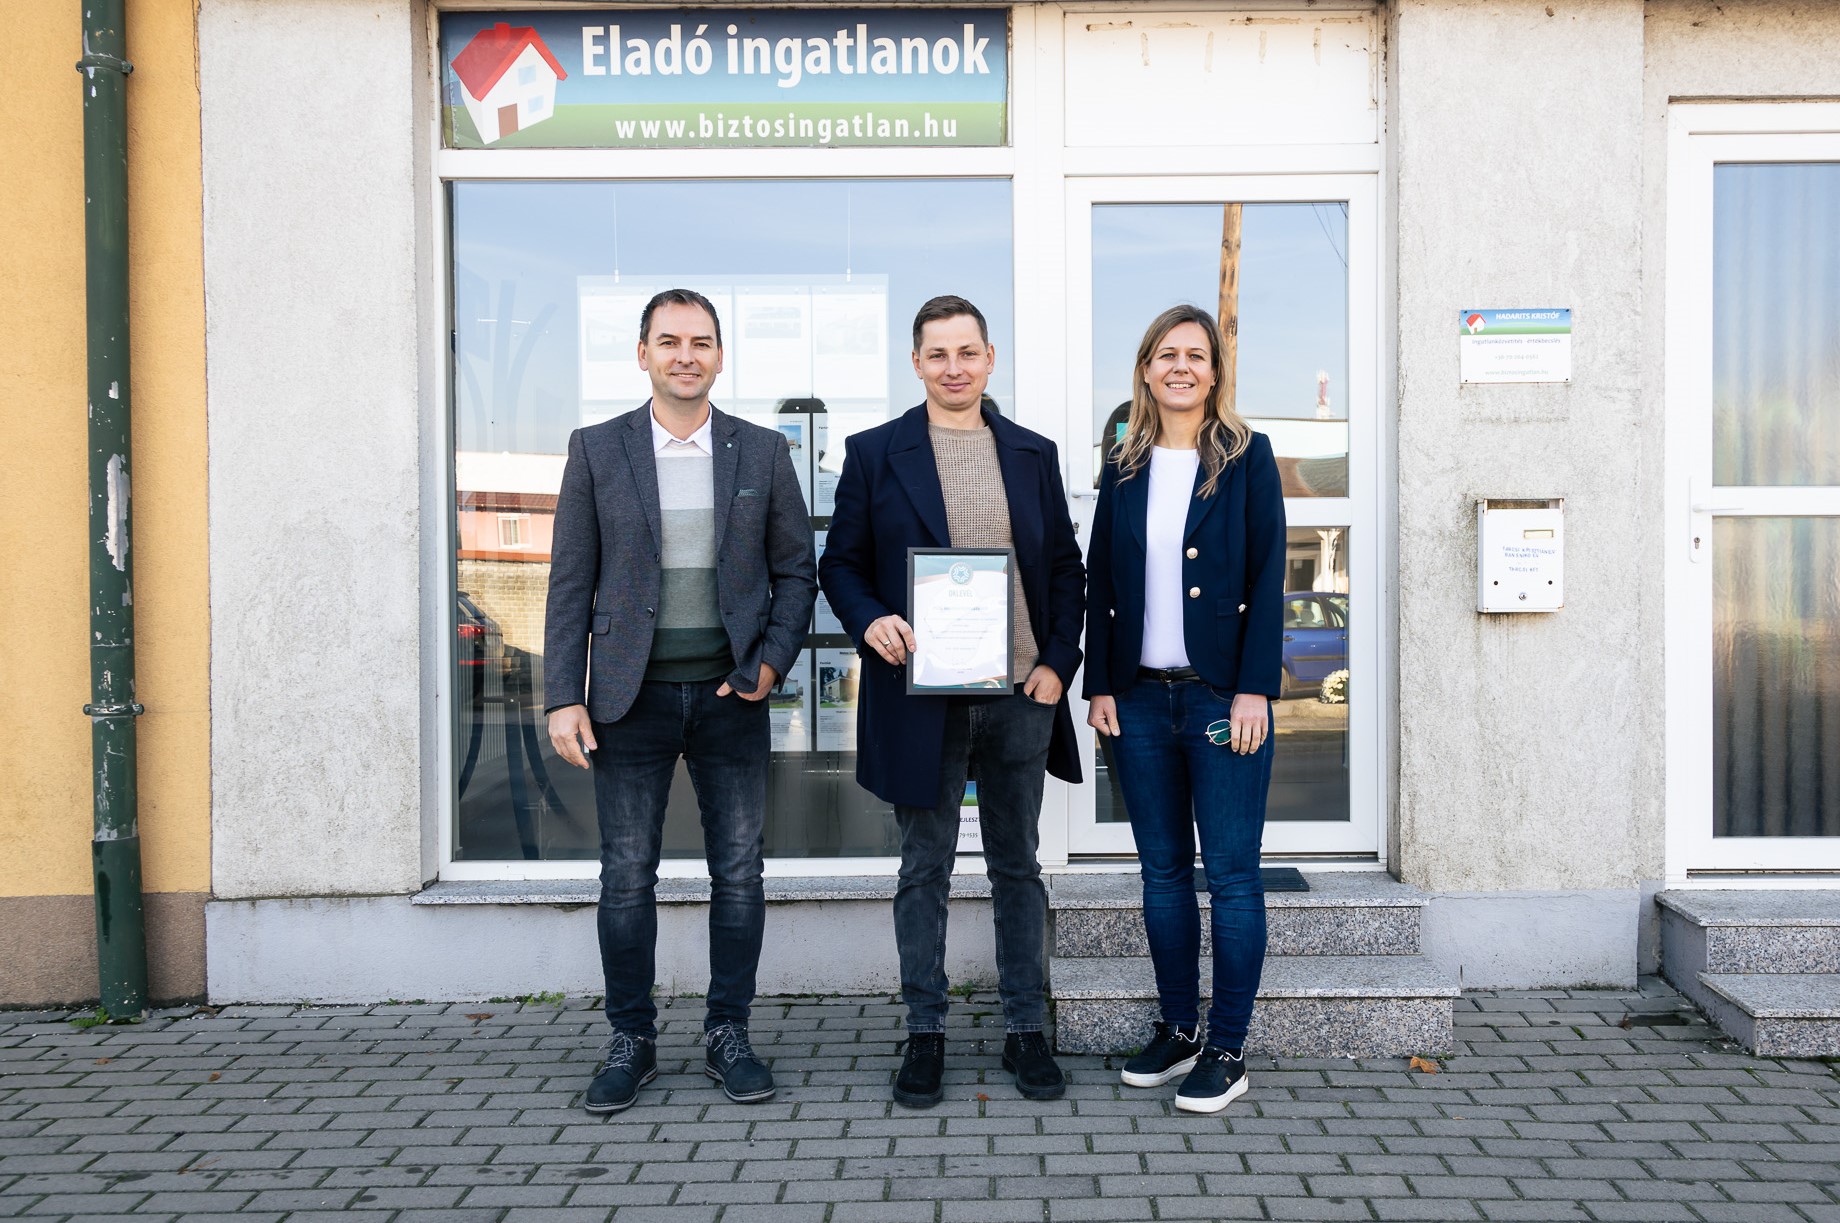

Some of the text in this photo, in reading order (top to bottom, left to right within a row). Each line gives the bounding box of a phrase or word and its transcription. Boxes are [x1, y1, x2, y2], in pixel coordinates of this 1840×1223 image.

[582, 24, 991, 88] Eladó ingatlanok
[615, 112, 957, 143] www.biztosingatlan.hu
[1495, 311, 1561, 320] HADARITS KRISTÓF
